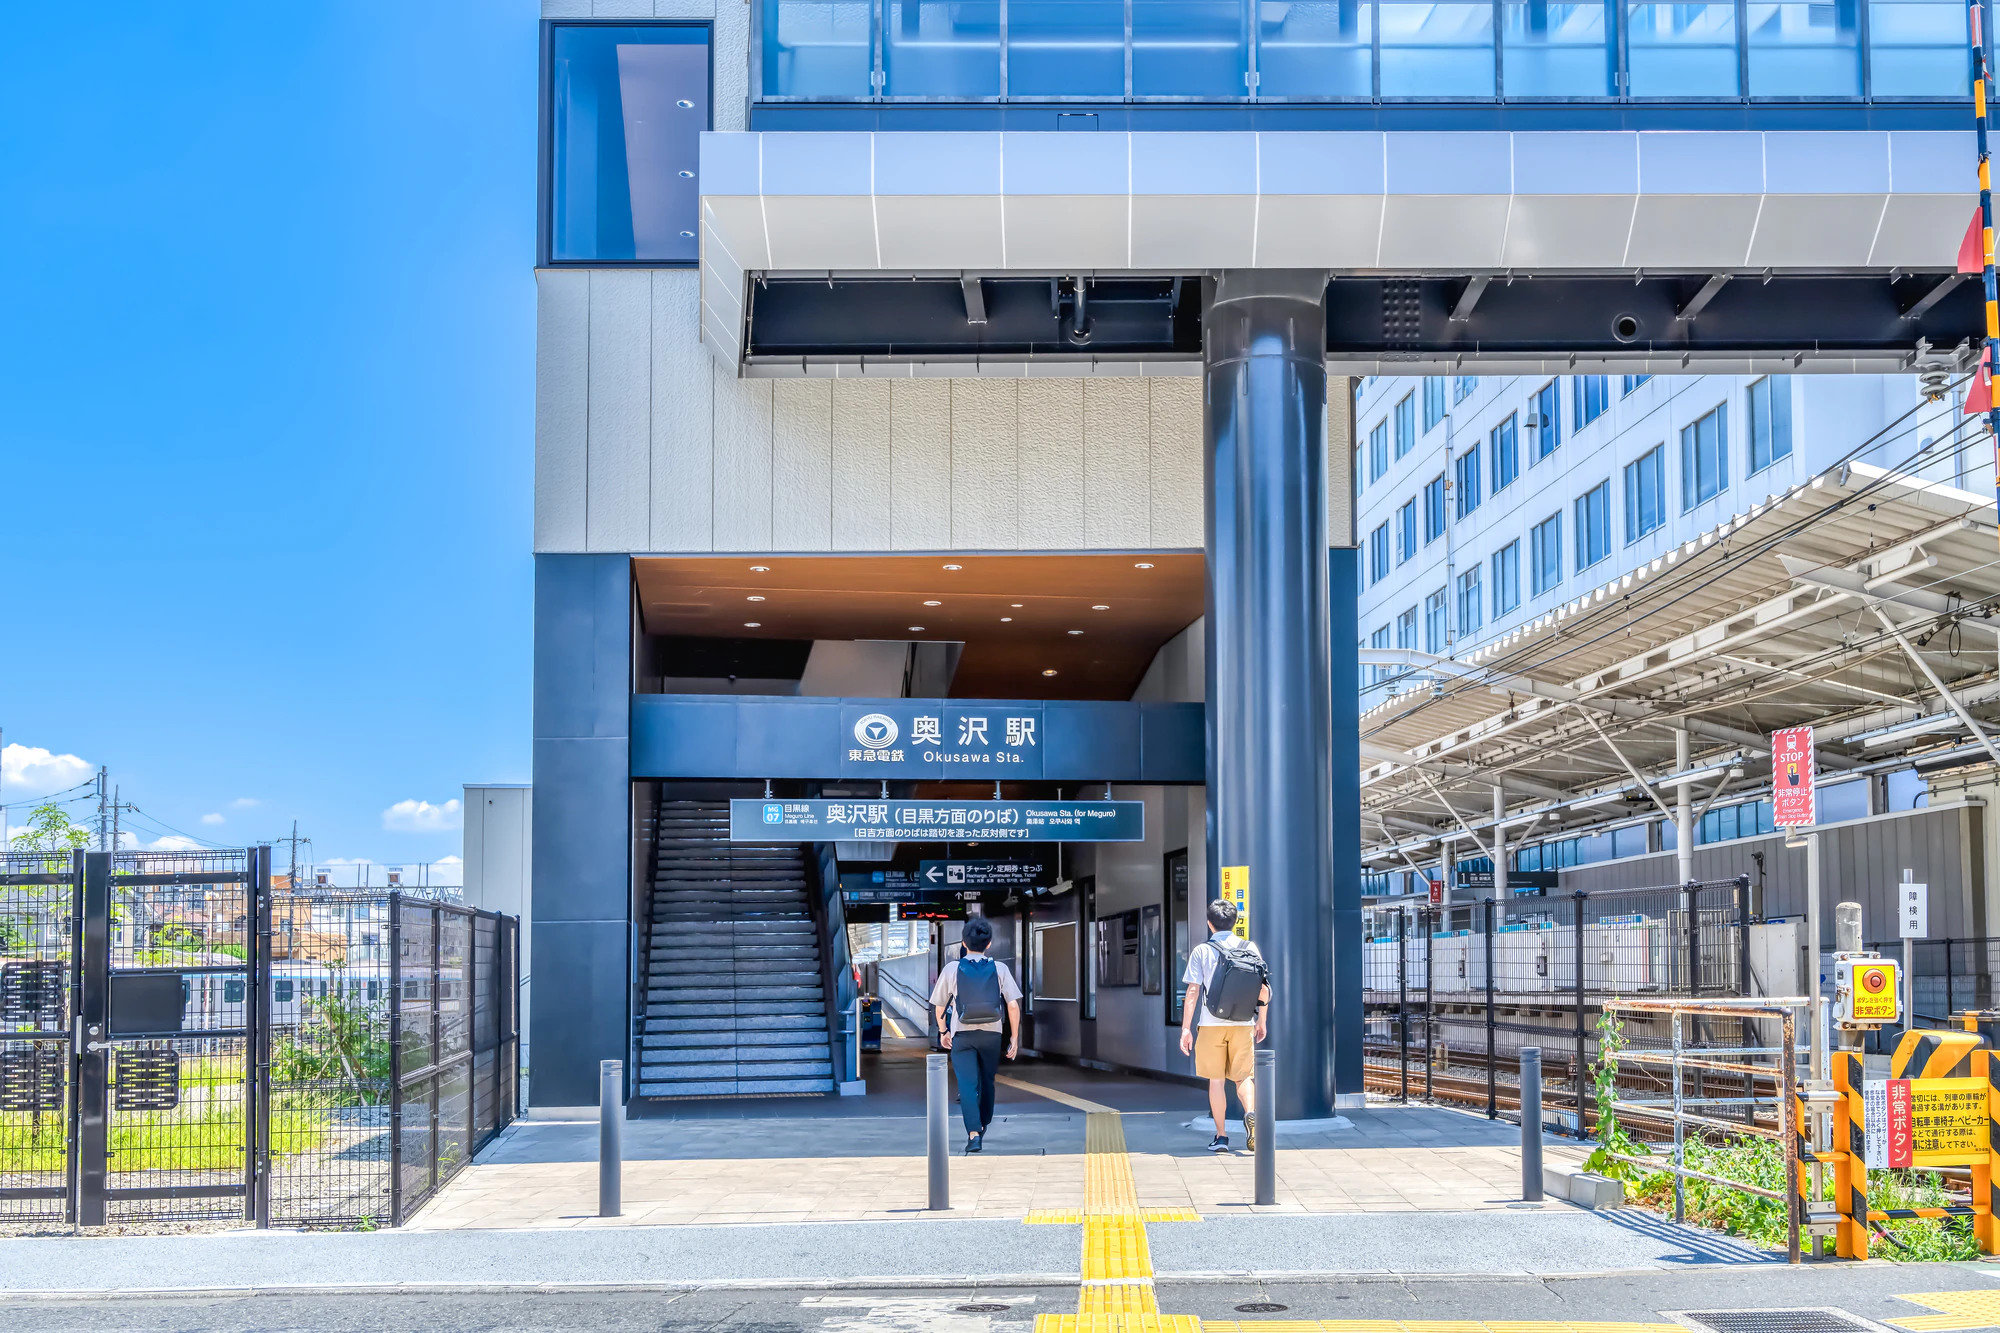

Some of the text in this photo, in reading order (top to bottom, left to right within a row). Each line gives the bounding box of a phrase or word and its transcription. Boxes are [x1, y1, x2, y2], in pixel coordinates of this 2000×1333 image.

[911, 715, 1036, 746] 奥沢駅
[849, 749, 905, 762] 東急電鉄
[923, 751, 1024, 763] Okusawa Sta.
[1780, 751, 1804, 763] STOP
[1777, 787, 1808, 799] 非常停止
[784, 804, 810, 813] 目黒線
[1781, 797, 1804, 808] ボタン
[766, 813, 780, 822] 07
[1025, 808, 1116, 819] Okusawa Sta. (for Meguro)
[1461, 873, 1466, 884] 1
[1908, 891, 1918, 930] 障検用
[1855, 1005, 1895, 1016] 非常ボタン
[1892, 1085, 1907, 1162] 非常ボタン
